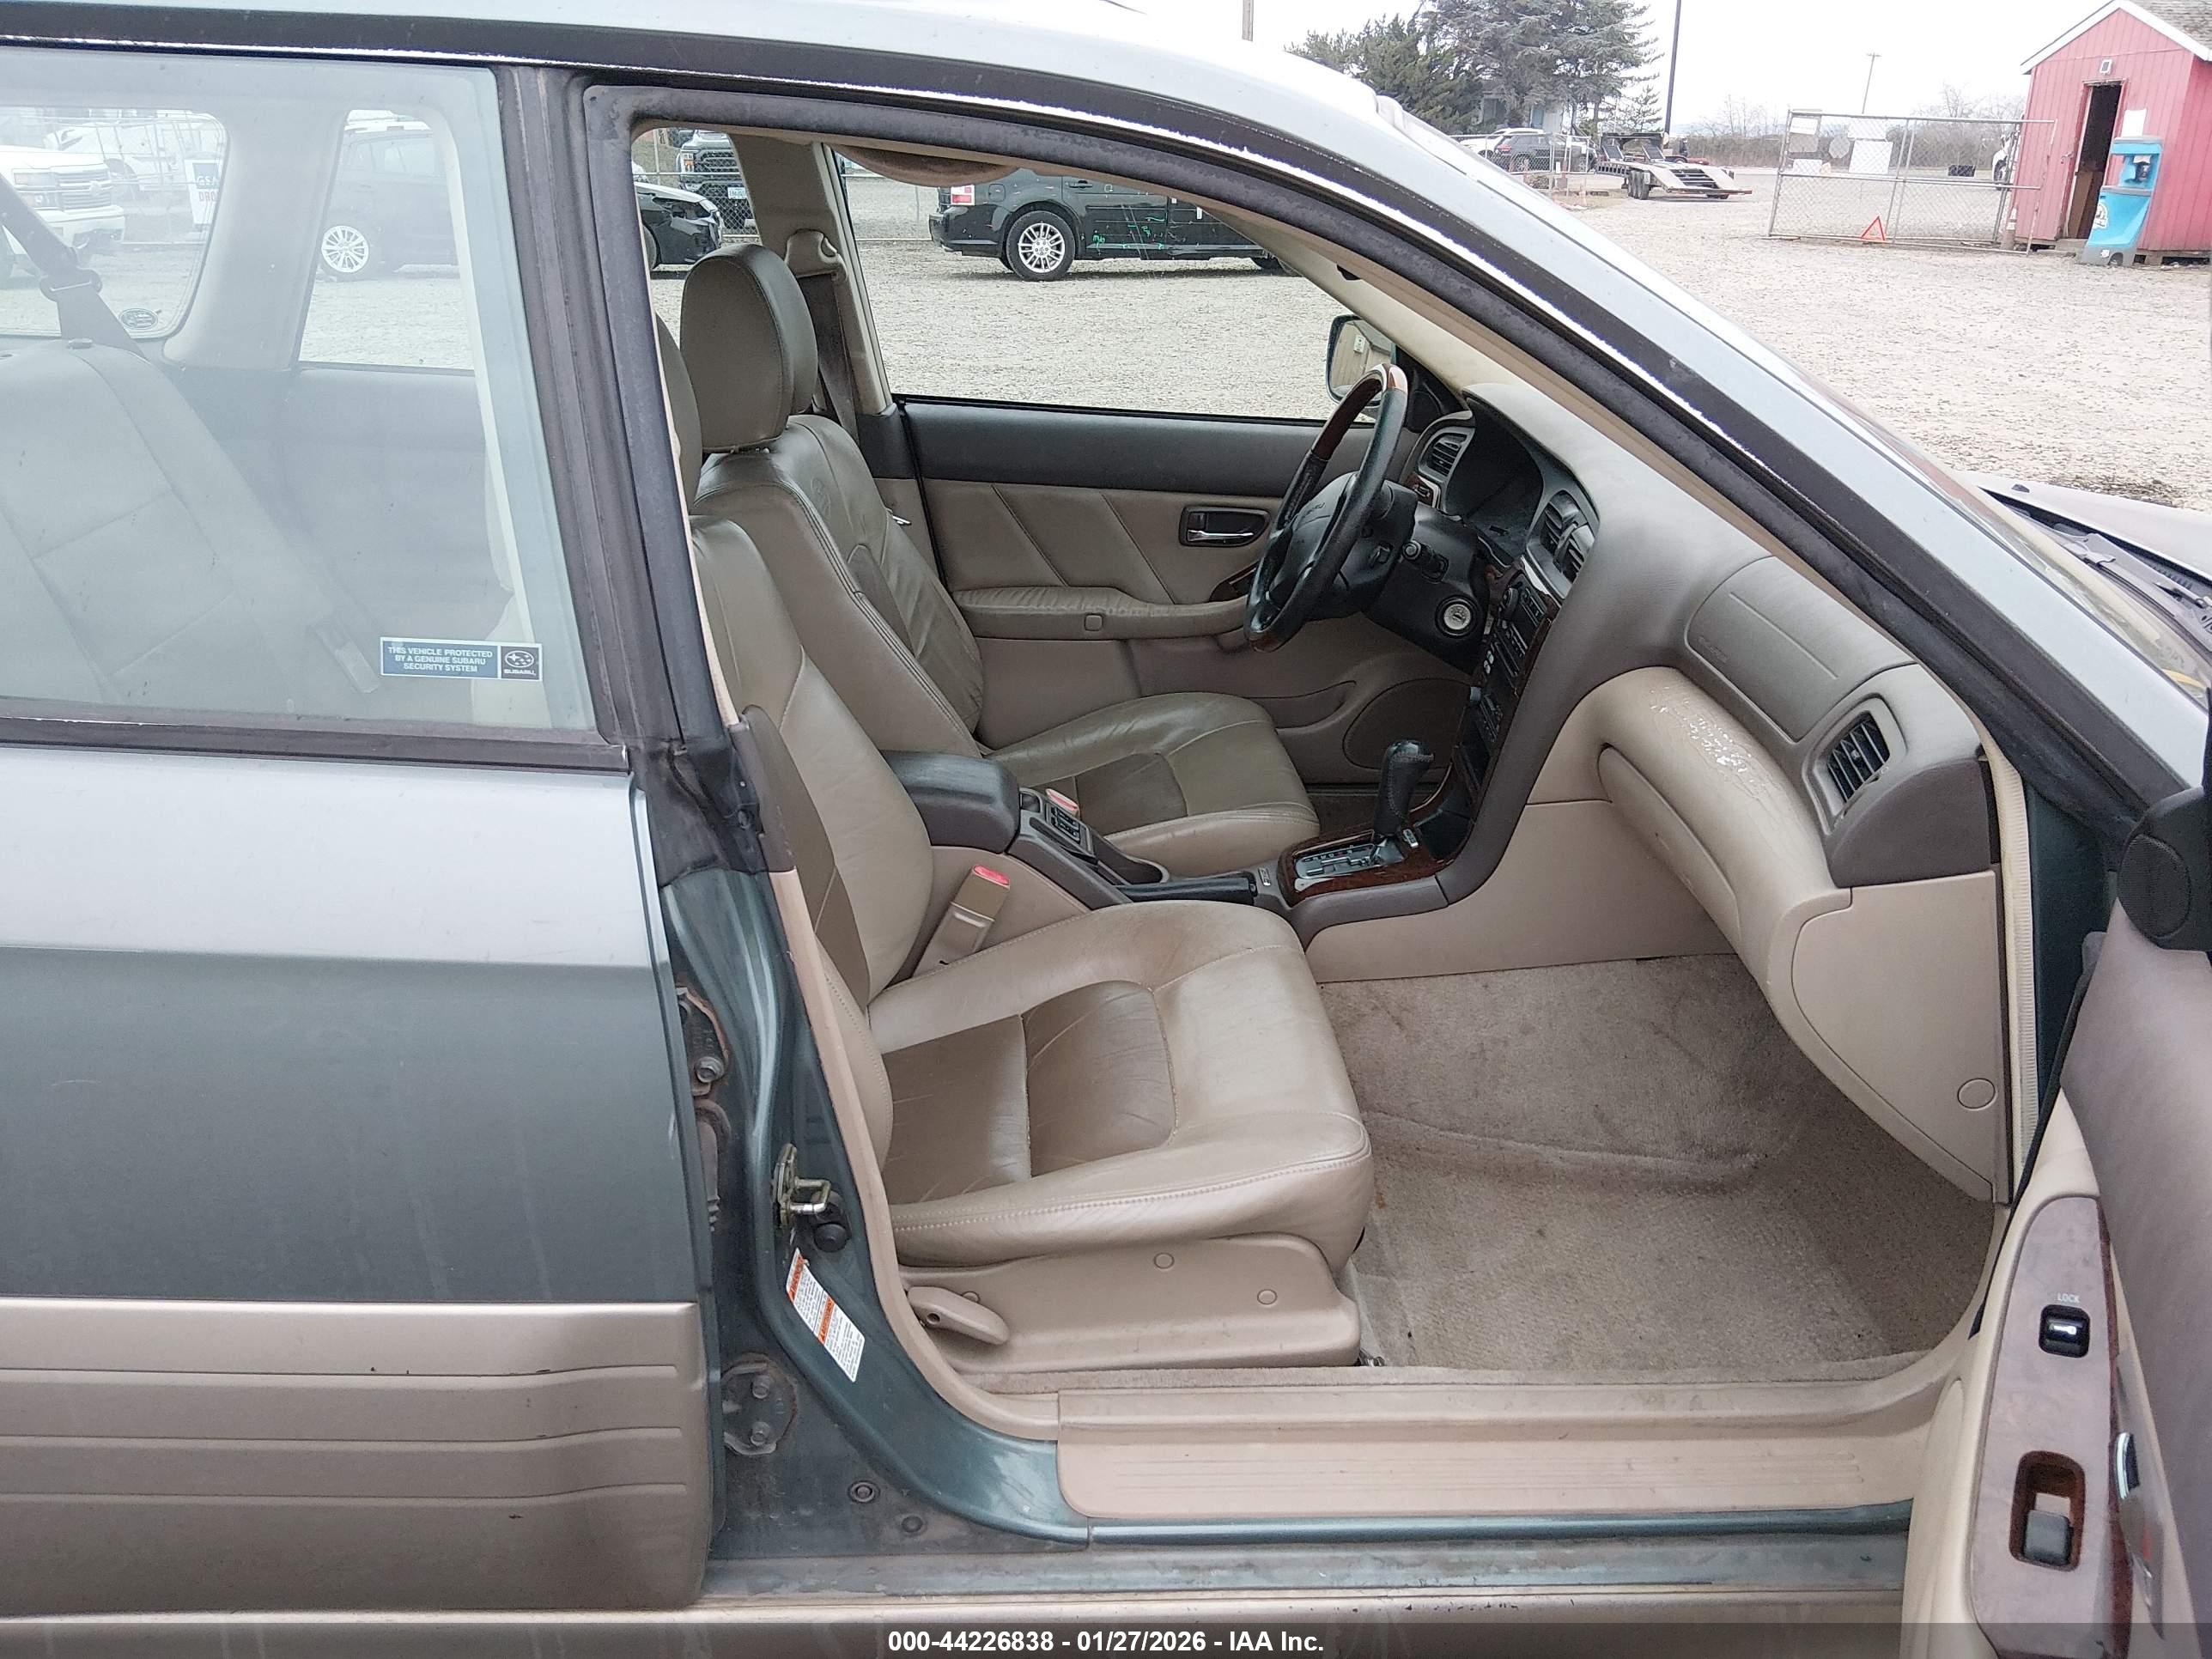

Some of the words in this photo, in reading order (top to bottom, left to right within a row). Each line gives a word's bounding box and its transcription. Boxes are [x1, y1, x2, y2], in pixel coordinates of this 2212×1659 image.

[387, 646, 406, 654] THIS
[407, 647, 443, 656] VEHICLE
[444, 649, 493, 658] PROTECTED
[414, 655, 451, 664] GENUINE
[452, 657, 486, 665] SUBARU
[404, 662, 444, 672] SECURITY
[445, 664, 478, 672] SYSTEM
[2057, 1292, 2081, 1304] LOCK
